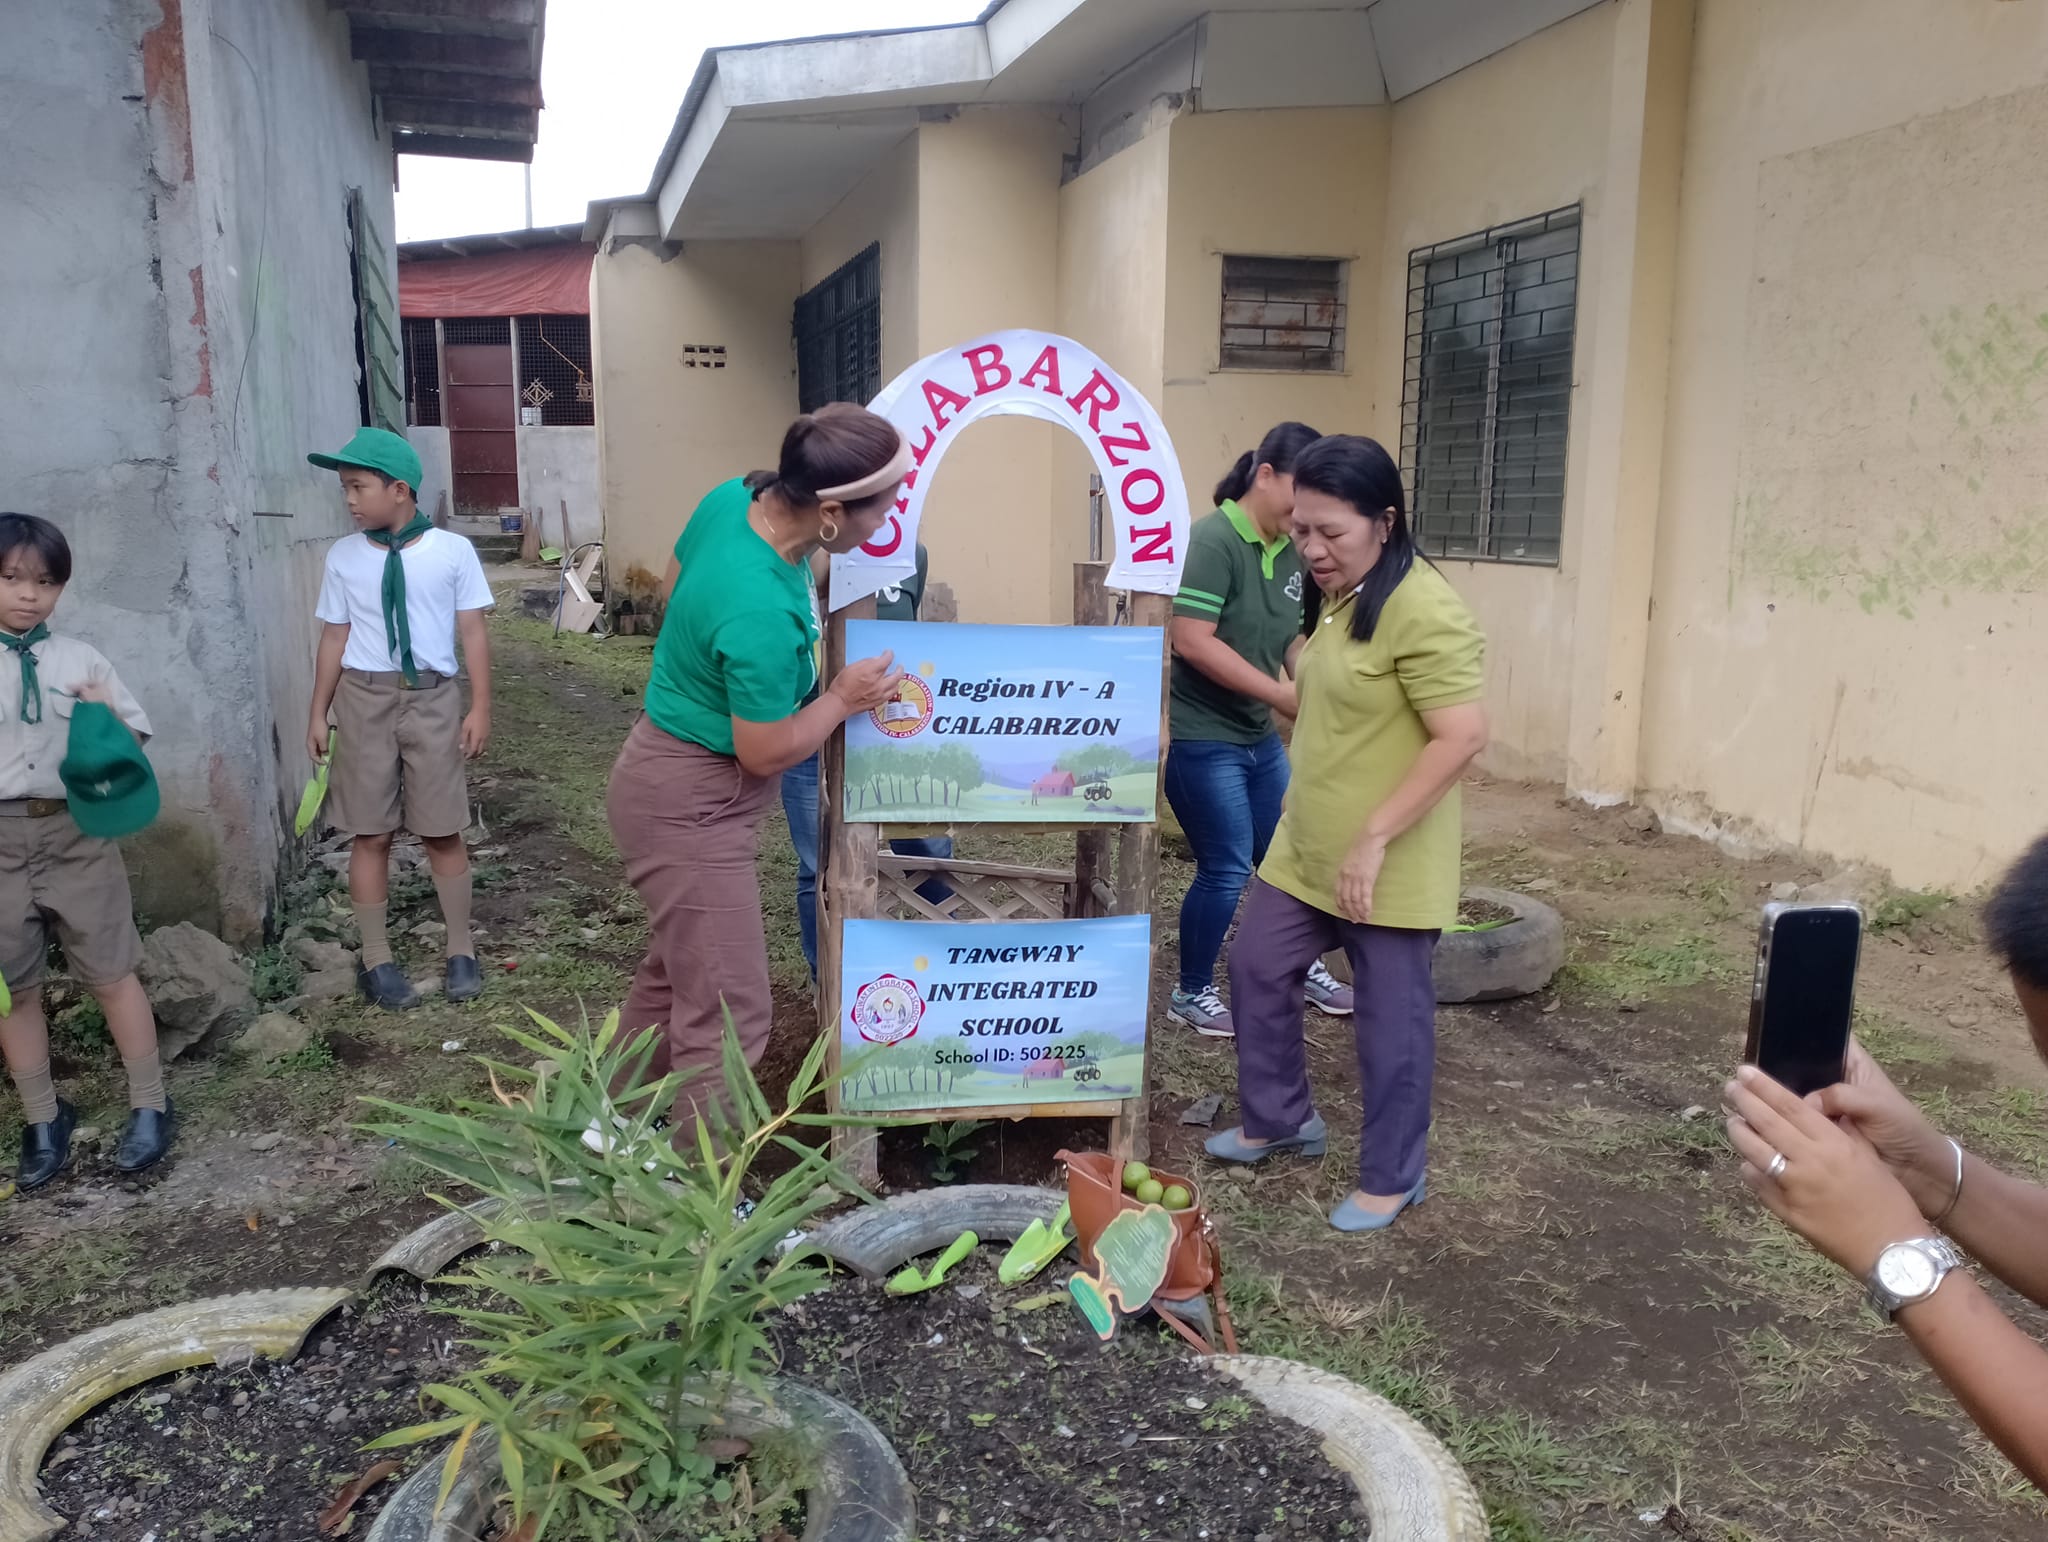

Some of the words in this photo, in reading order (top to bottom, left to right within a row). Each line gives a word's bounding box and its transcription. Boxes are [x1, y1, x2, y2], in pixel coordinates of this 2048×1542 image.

[937, 676, 1035, 703] Region
[1040, 680, 1074, 699] IV
[1095, 680, 1115, 700] A
[932, 716, 1121, 737] CALABARZON
[947, 944, 1084, 965] TANGWAY
[926, 980, 1098, 1002] INTEGRATED
[958, 1016, 1064, 1037] SCHOOL
[934, 1049, 989, 1065] School
[993, 1048, 1015, 1062] ID:
[1020, 1044, 1087, 1061] 502225
